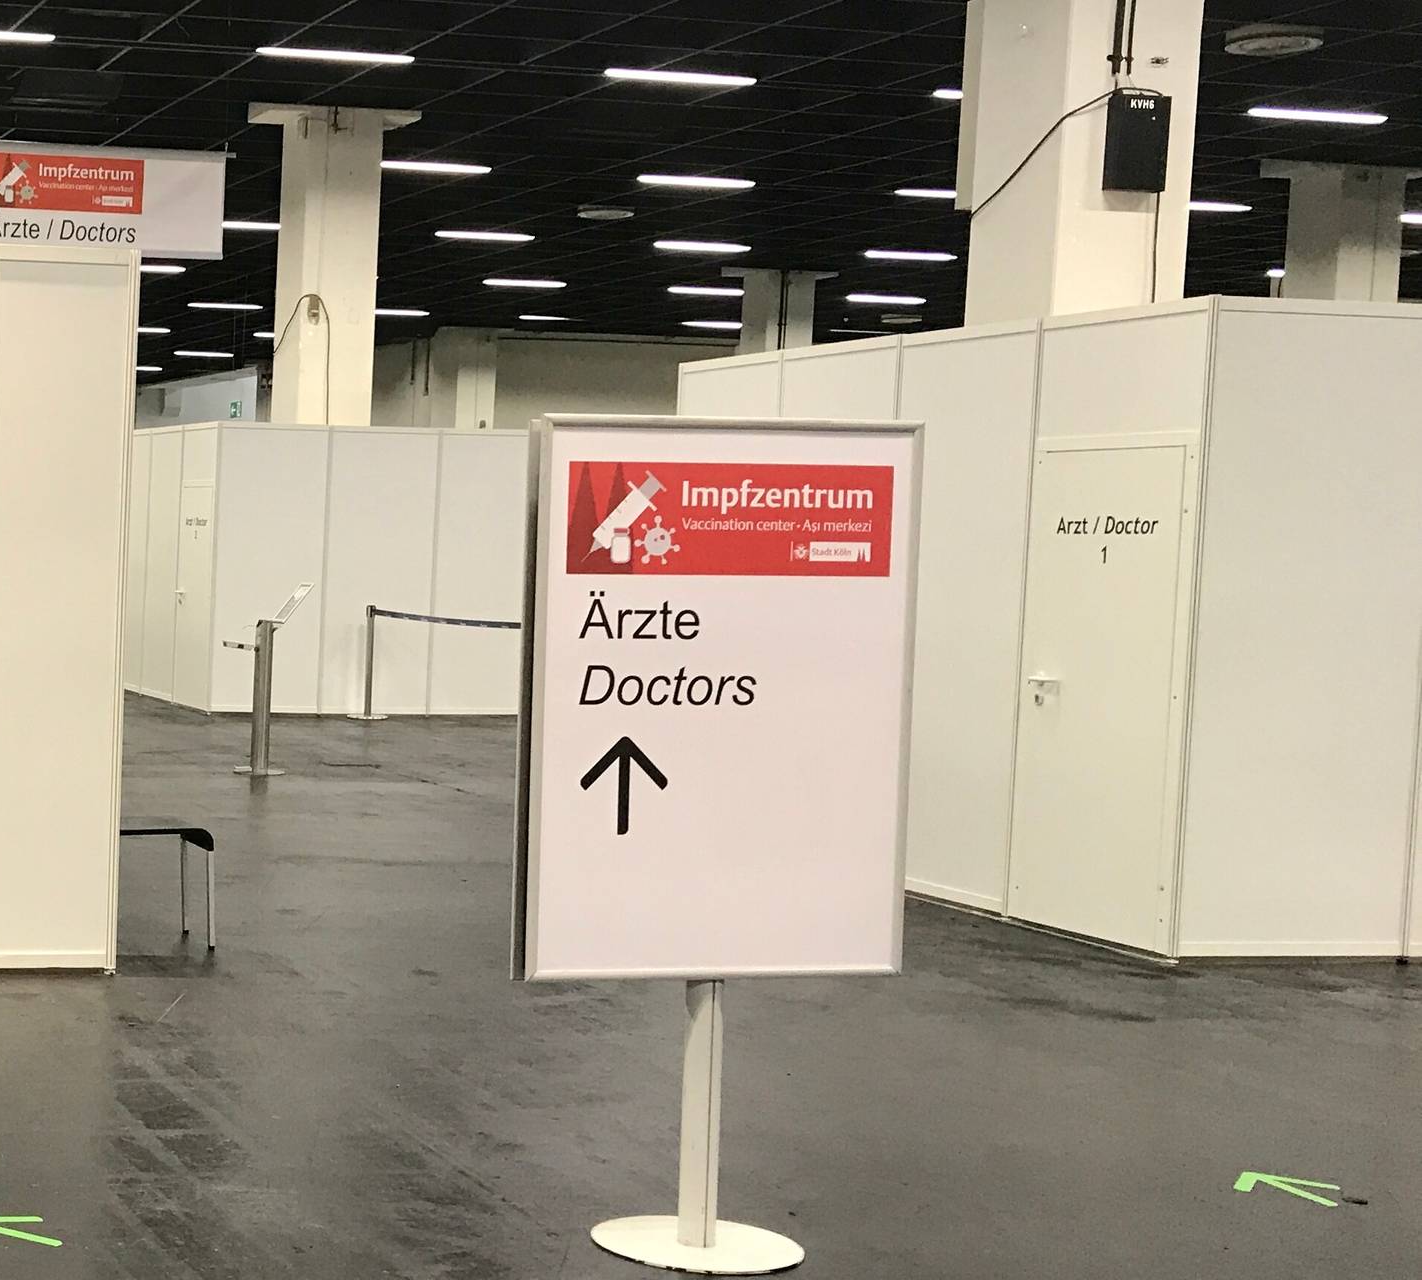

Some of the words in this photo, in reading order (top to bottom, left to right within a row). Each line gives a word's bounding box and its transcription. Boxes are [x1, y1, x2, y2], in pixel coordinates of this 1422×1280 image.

[1130, 98, 1155, 110] KVH6
[39, 163, 134, 181] Impfzentrum
[59, 219, 136, 243] Doctors
[681, 479, 874, 515] Impfzentrum
[682, 518, 753, 531] Vaccination
[756, 519, 796, 532] center
[823, 518, 872, 532] merkezi
[1057, 516, 1088, 535] Arzt
[1104, 516, 1158, 535] Doctor
[1101, 545, 1107, 564] 1
[578, 591, 700, 640] Ärzte
[578, 664, 757, 706] Doctors
